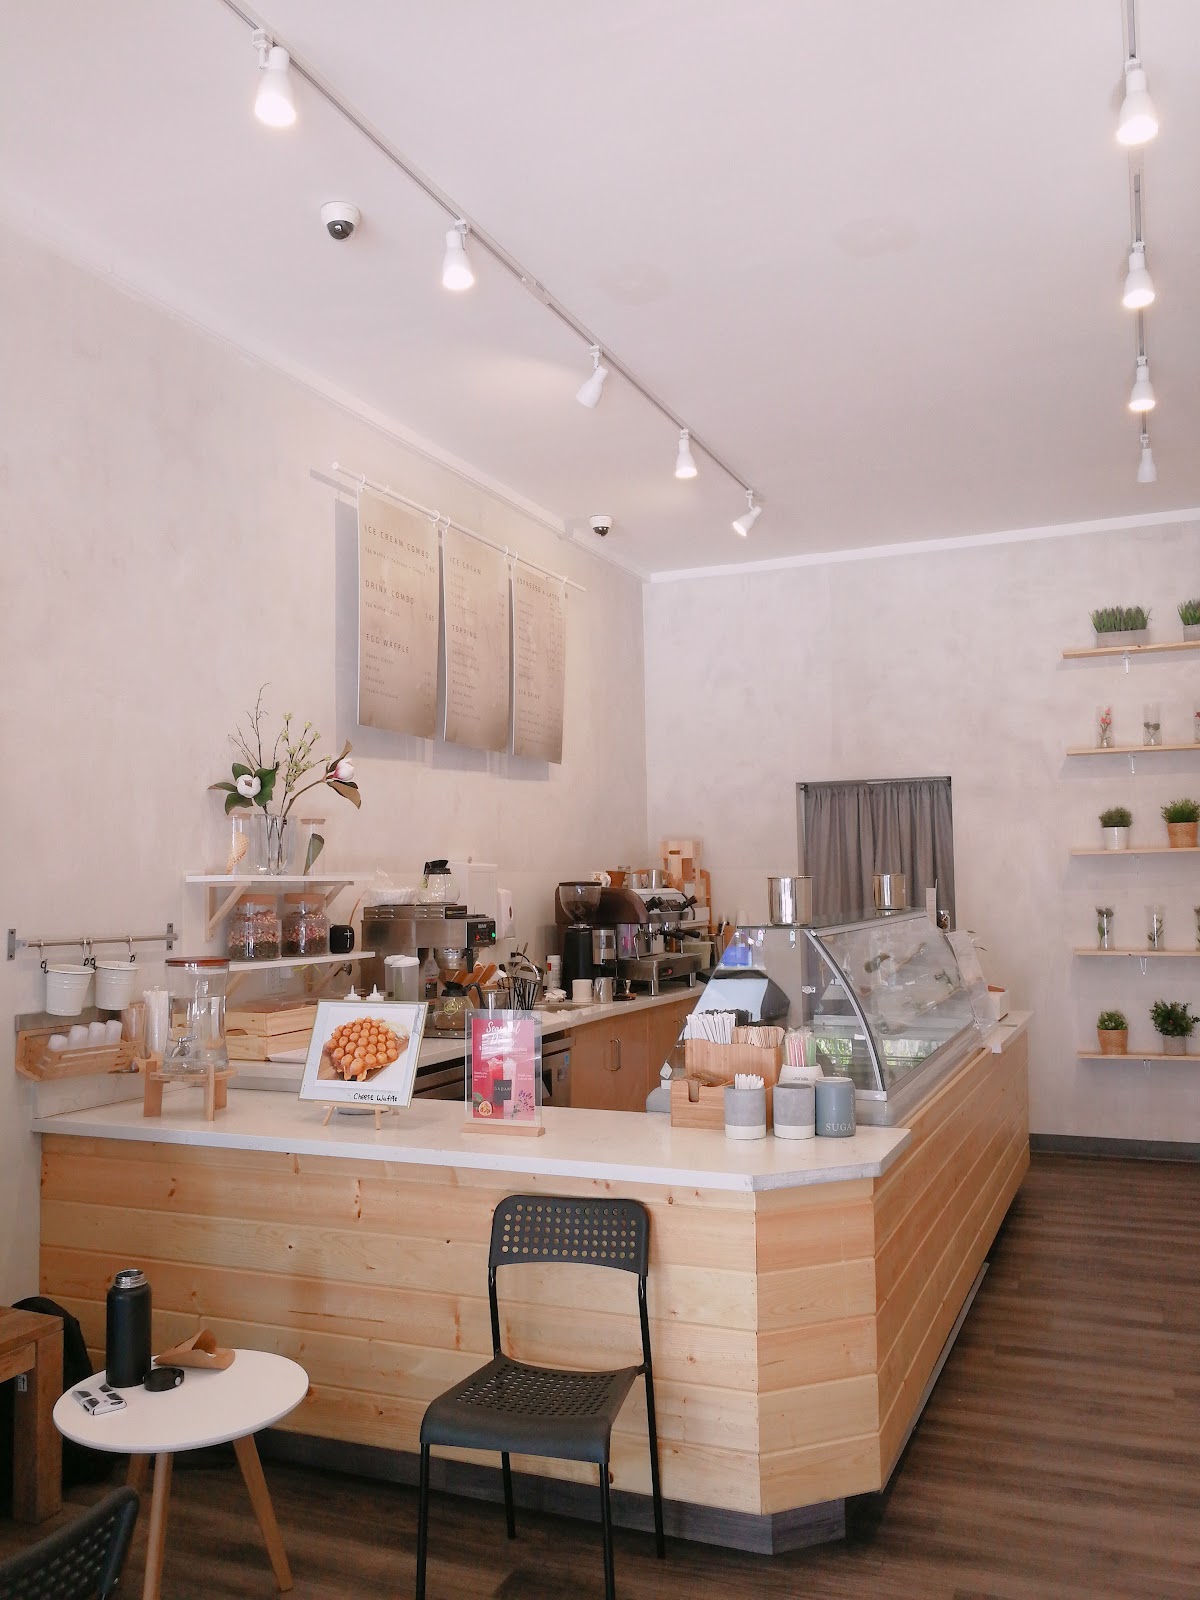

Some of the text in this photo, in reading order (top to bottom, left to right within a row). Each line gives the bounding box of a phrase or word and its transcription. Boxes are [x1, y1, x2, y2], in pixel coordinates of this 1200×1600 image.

[365, 524, 430, 560] ICE CREAM COMBO
[449, 556, 482, 576] ICE CREAM
[365, 579, 415, 606] DRINK COMBO
[516, 576, 541, 593] ESPRESSO
[452, 624, 477, 640] TOPPING
[366, 633, 410, 654] EGG WAFFLE
[486, 1021, 521, 1034] Seaal
